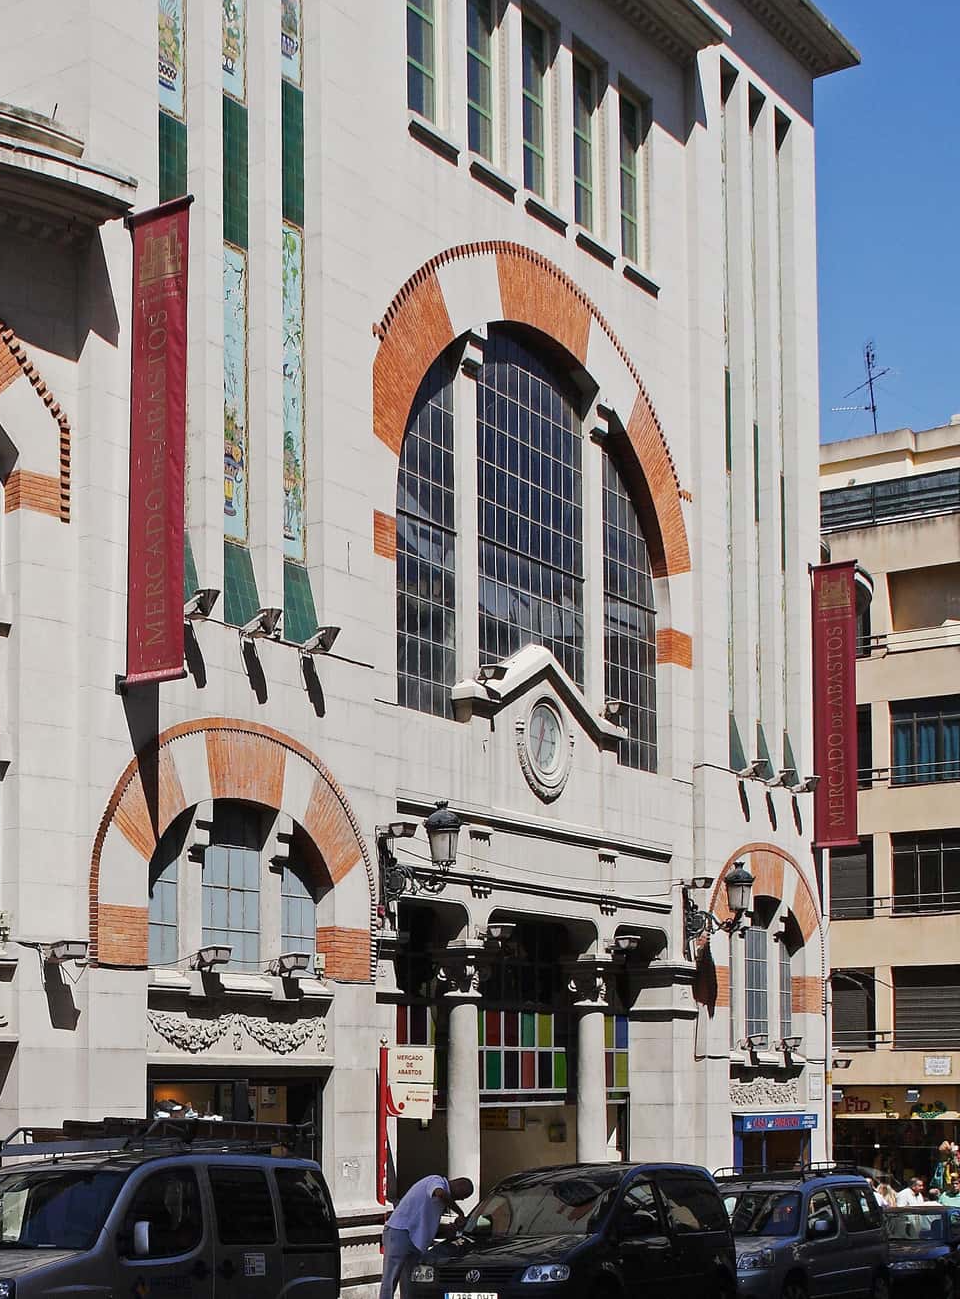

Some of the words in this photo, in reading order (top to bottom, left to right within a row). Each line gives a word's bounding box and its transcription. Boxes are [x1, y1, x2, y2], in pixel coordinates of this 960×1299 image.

[148, 309, 169, 445] ABASTOS
[151, 448, 166, 481] DE
[144, 488, 167, 649] MERCADO
[826, 626, 843, 707] ABASTOS
[831, 713, 843, 728] DE
[827, 733, 844, 827] MERCADO
[396, 1054, 424, 1062] MERCADO
